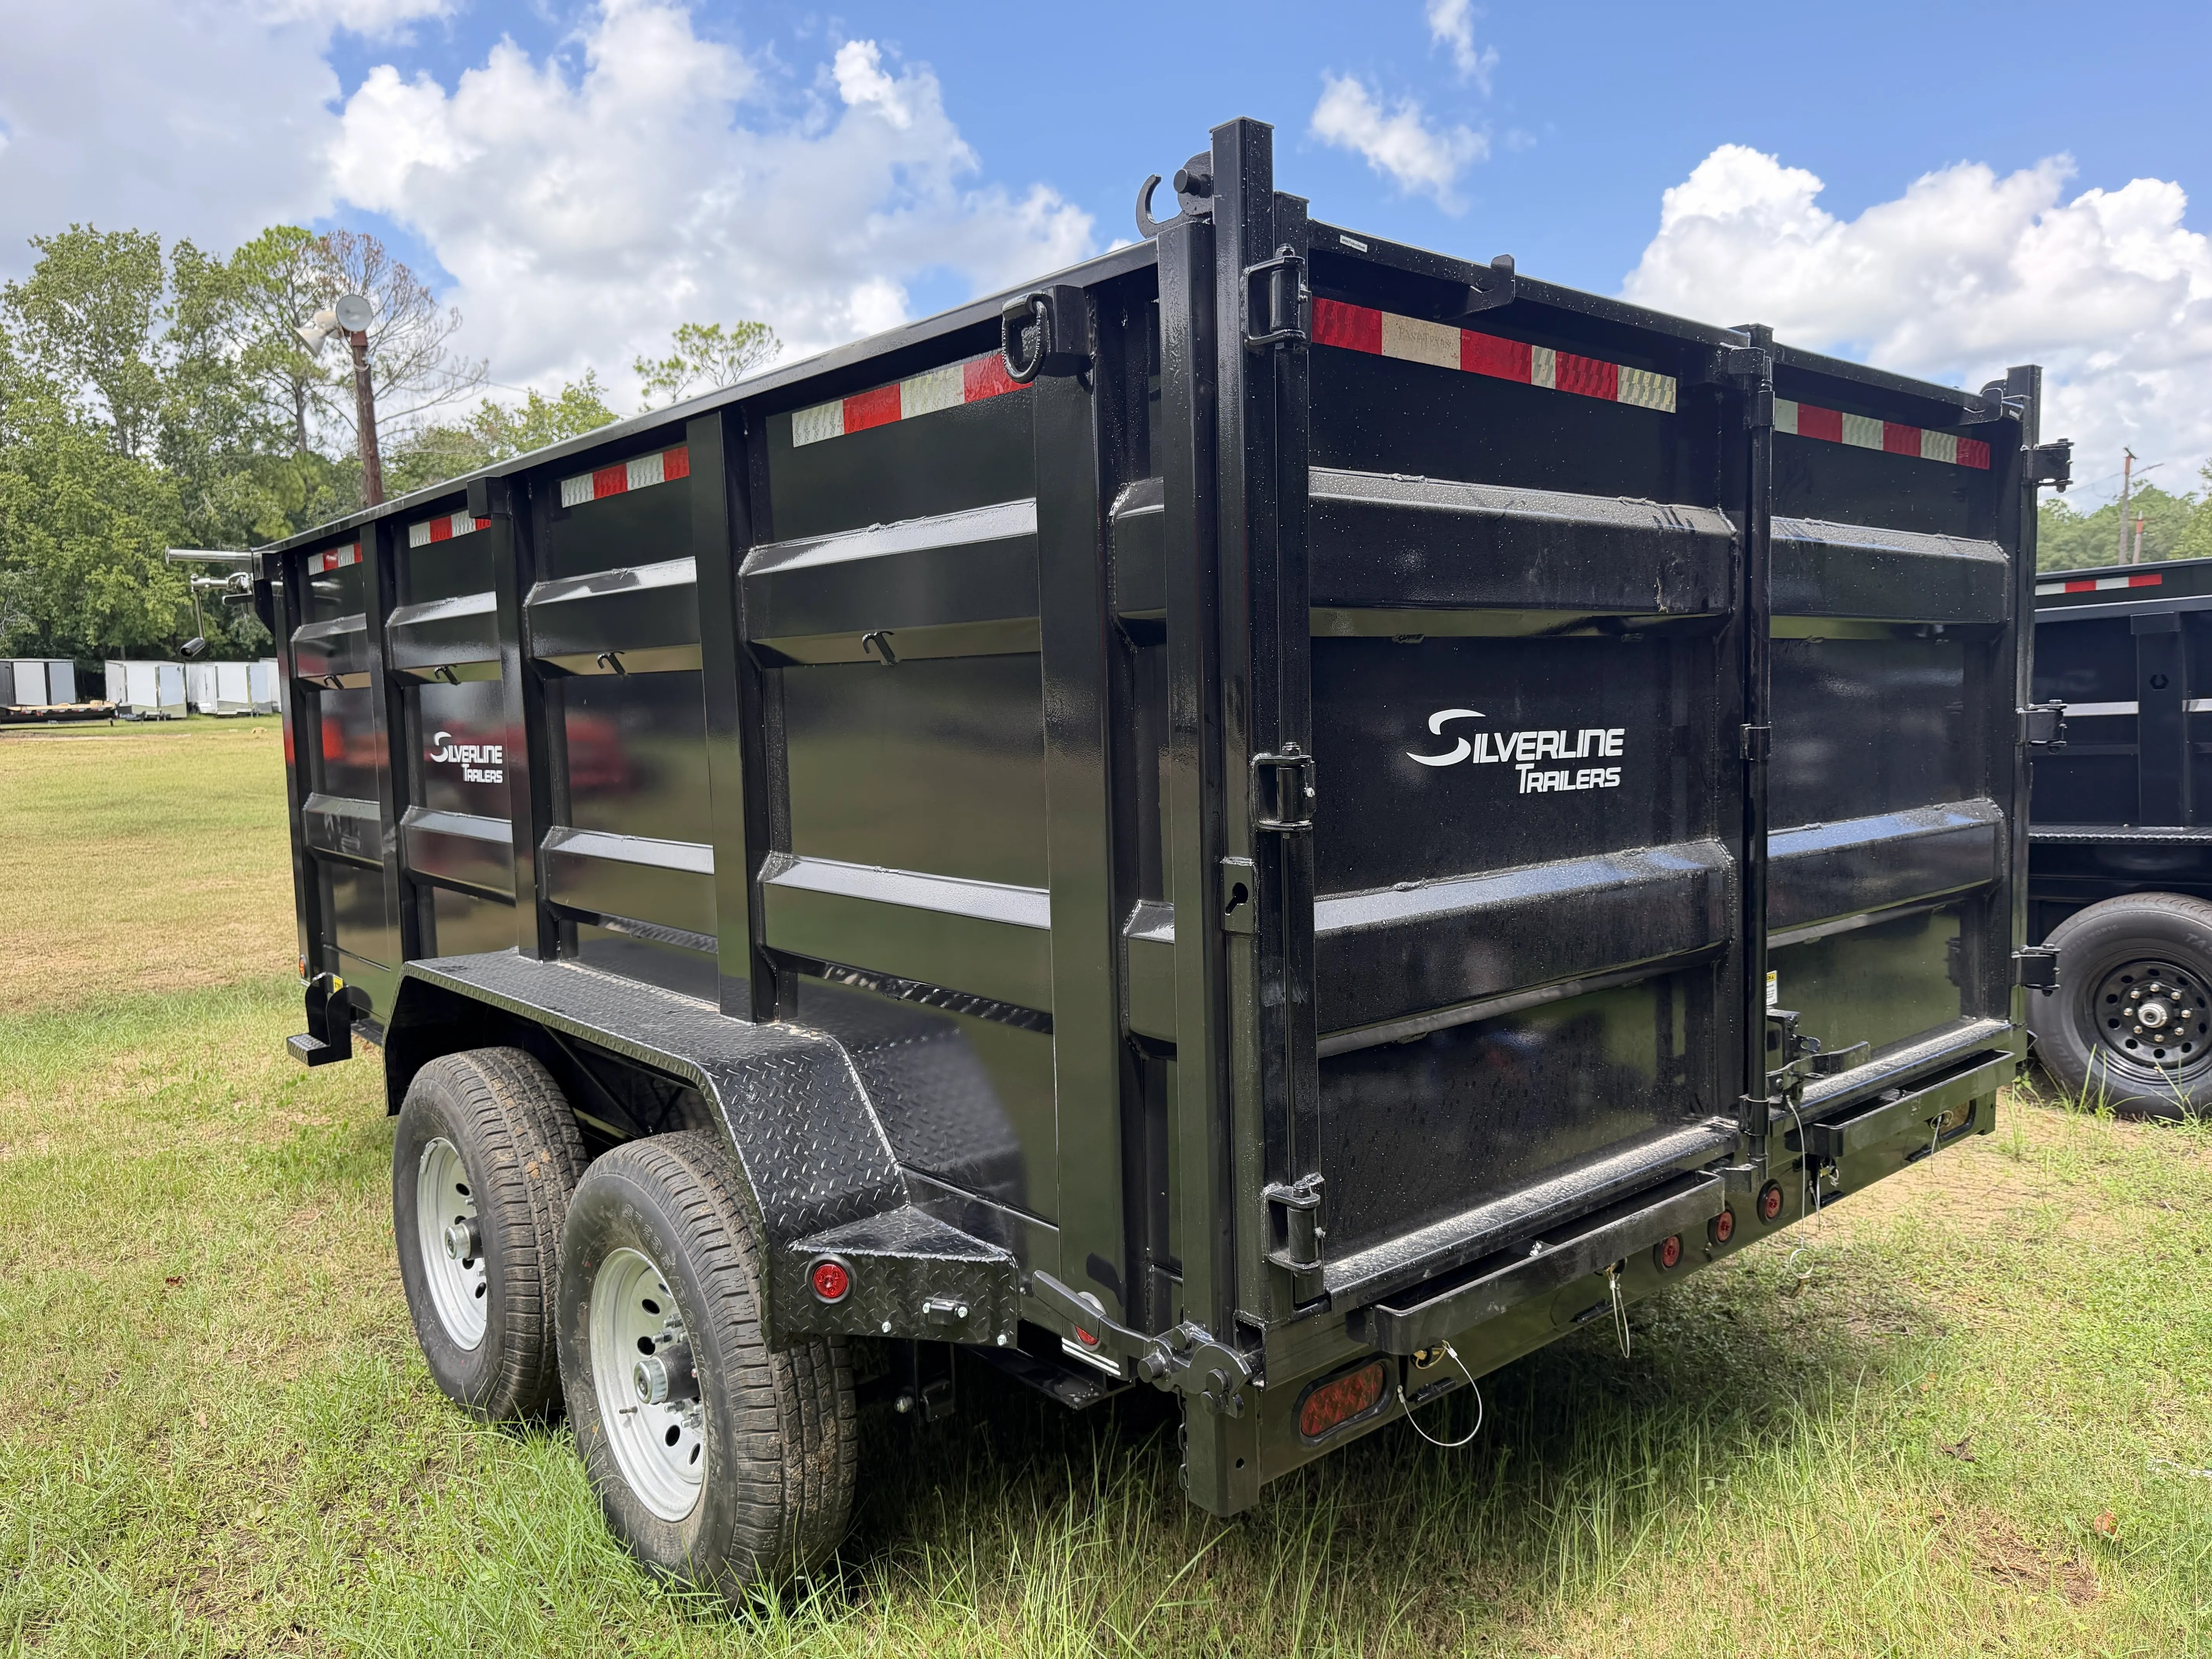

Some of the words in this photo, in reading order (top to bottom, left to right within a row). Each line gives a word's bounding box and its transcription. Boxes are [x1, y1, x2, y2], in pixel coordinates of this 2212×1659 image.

[430, 731, 503, 764] SILVERLINE
[1406, 709, 1625, 766] SILVERLINE
[461, 764, 503, 783] TRAILERS
[1515, 763, 1622, 793] TRAILERS
